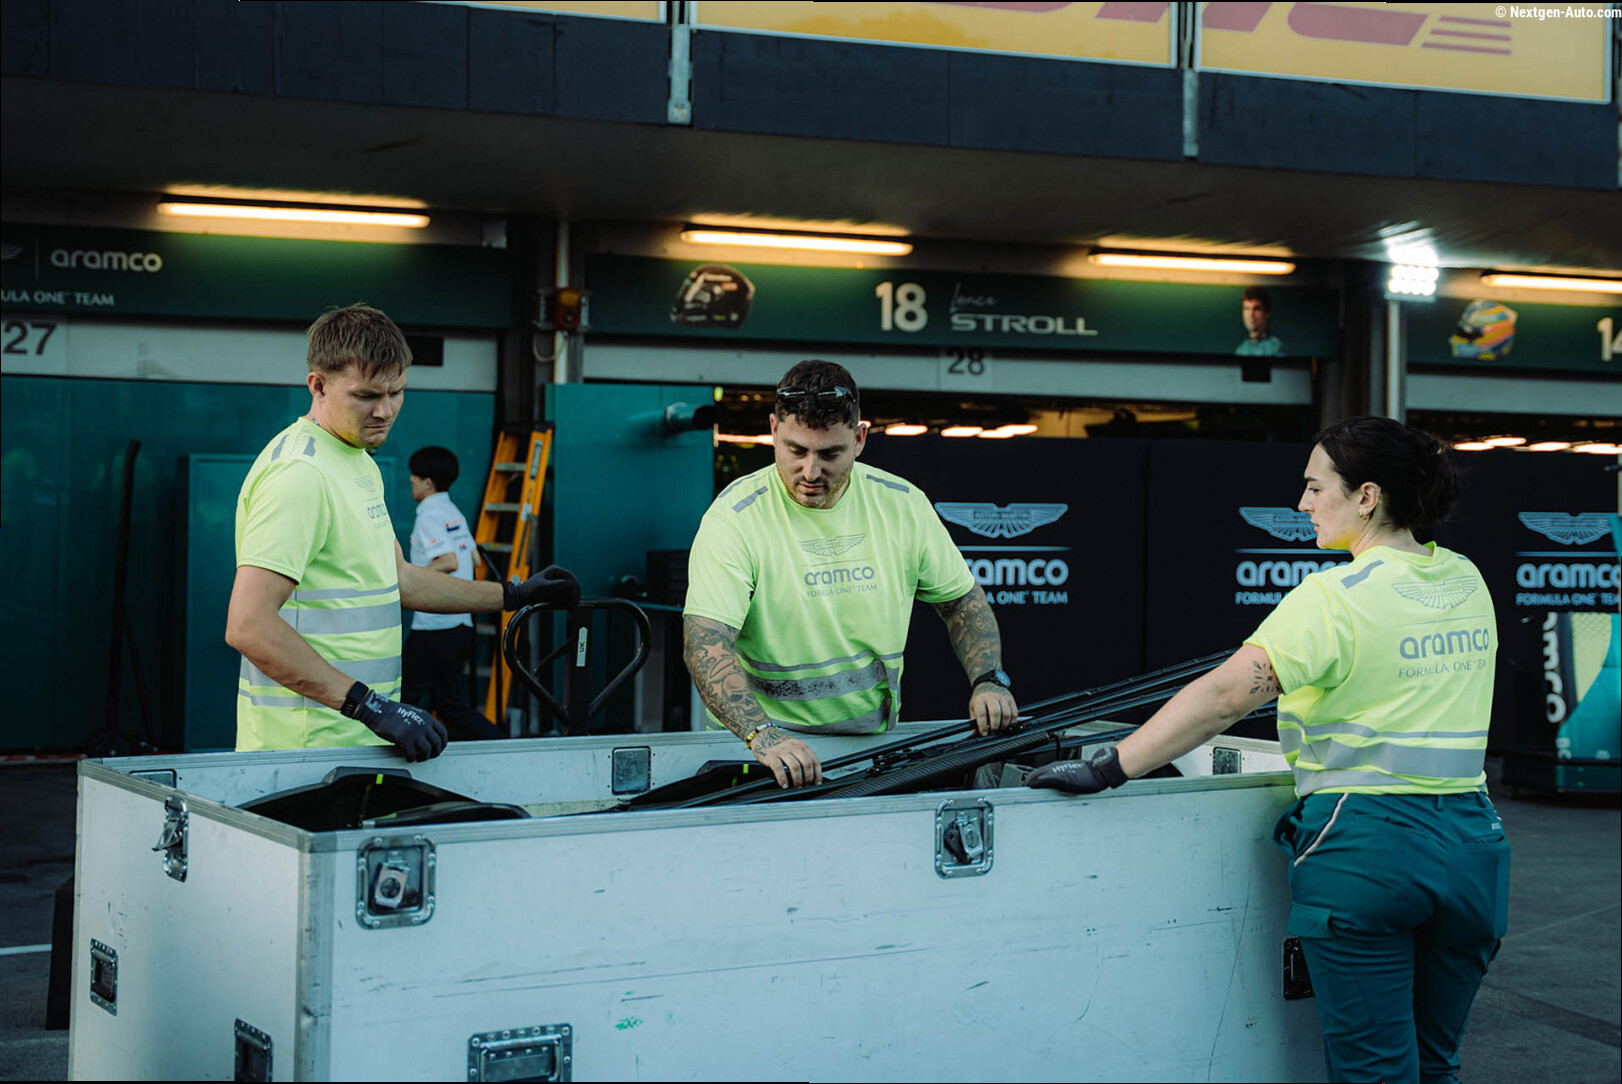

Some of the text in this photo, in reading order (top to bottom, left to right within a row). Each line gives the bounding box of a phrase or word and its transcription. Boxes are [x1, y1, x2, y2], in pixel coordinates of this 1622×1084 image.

[51, 249, 163, 272] aramco
[1, 288, 115, 306] ULA ONE TEAM
[876, 281, 929, 333] 18
[951, 313, 1099, 336] STROLL
[3, 321, 57, 355] 27
[947, 348, 985, 376] 28
[804, 566, 875, 586] aramco
[965, 558, 1069, 586] amco
[1235, 561, 1350, 587] aram
[996, 590, 1026, 605] ONE
[1031, 590, 1068, 605] TEAM
[1235, 592, 1288, 605] FORMUL
[1516, 593, 1570, 606] FORMULA
[1399, 628, 1489, 659] aramco
[397, 706, 424, 726] HyFlex
[1052, 762, 1083, 773] HyFlex
